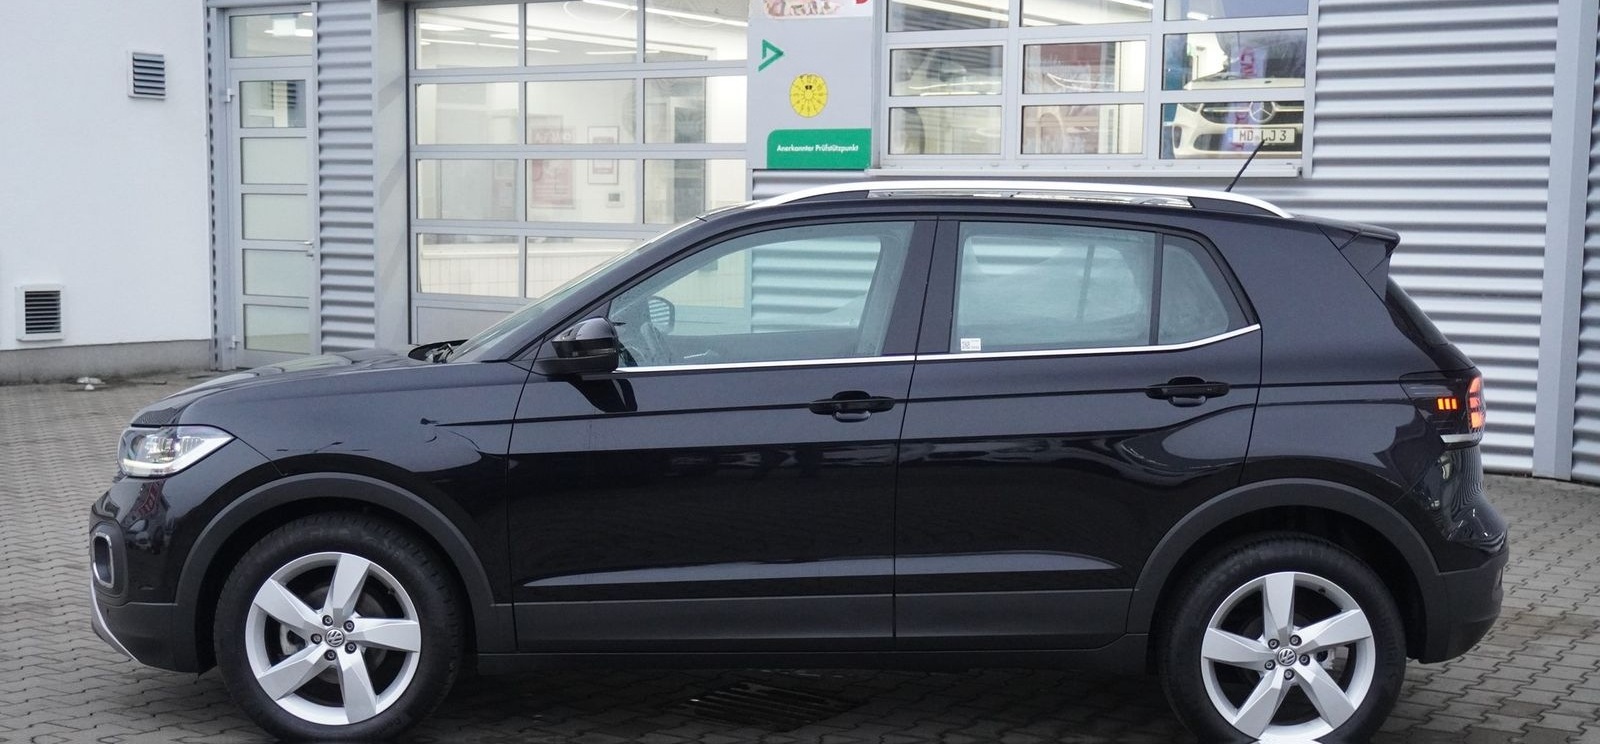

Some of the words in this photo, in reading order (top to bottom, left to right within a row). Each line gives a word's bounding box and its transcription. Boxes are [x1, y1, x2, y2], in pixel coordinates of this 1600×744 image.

[1239, 129, 1254, 142] MD
[1279, 129, 1287, 142] 3
[776, 144, 814, 152] Anerkannter
